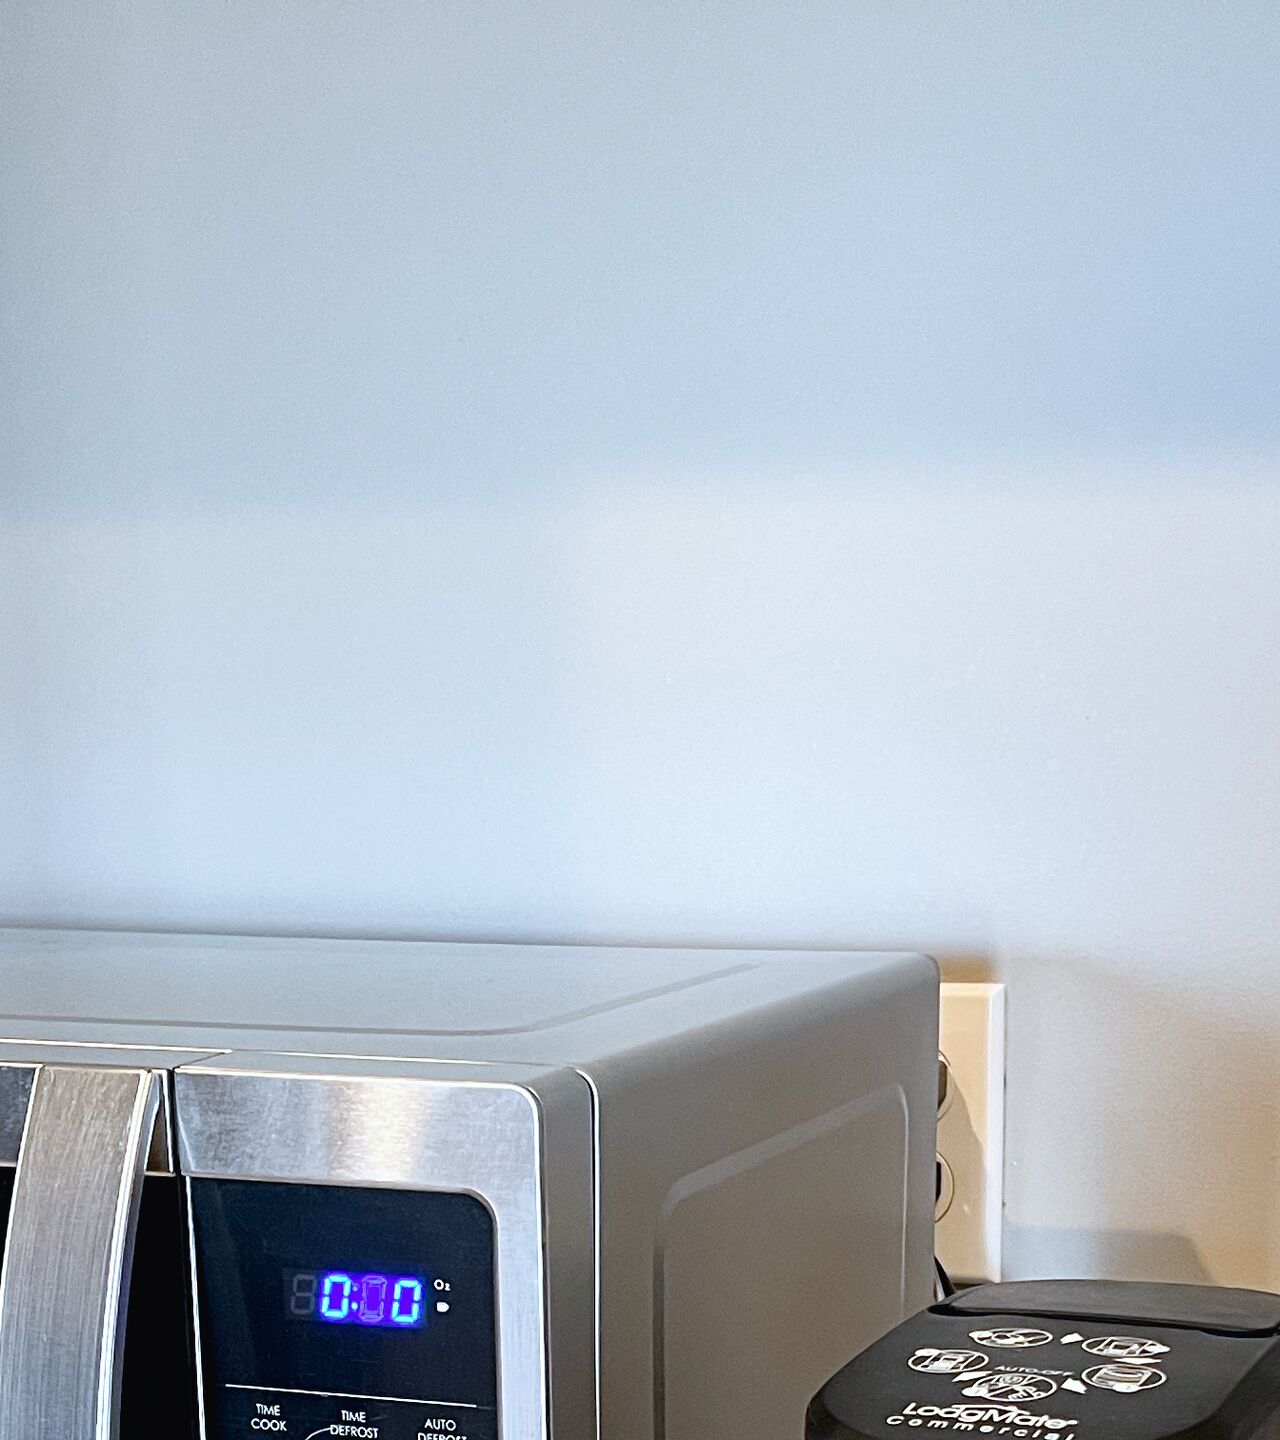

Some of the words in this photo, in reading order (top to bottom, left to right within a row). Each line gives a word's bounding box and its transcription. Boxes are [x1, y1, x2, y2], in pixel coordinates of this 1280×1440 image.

[255, 1403, 281, 1416] TIME
[341, 1410, 366, 1423] TIME
[250, 1418, 287, 1432] COOK
[424, 1418, 456, 1431] AUTO
[330, 1424, 378, 1439] DEFROST
